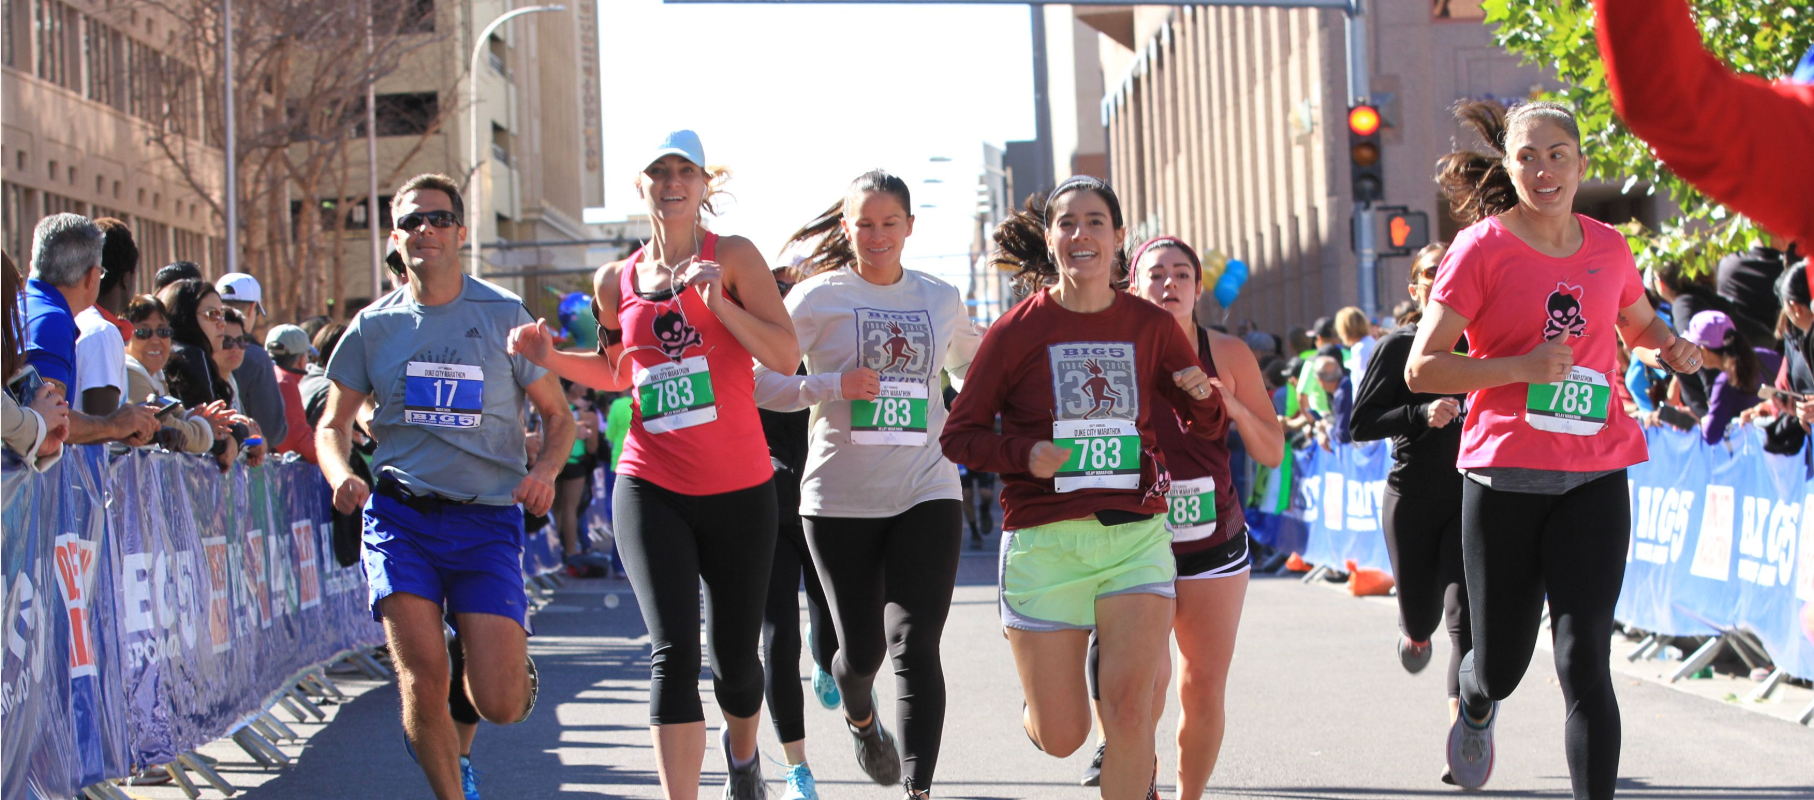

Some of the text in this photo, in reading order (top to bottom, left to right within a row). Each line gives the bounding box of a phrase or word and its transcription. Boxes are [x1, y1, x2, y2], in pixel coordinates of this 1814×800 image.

[444, 370, 466, 379] MARATHON
[1061, 362, 1083, 370] 1984
[433, 379, 458, 407] 17
[652, 377, 695, 412] 783
[890, 389, 911, 397] MARATHON
[1548, 382, 1593, 415] 783
[870, 398, 911, 427] 783
[1074, 427, 1122, 437] DUKE CITY MARATHON
[1074, 438, 1122, 470] 783
